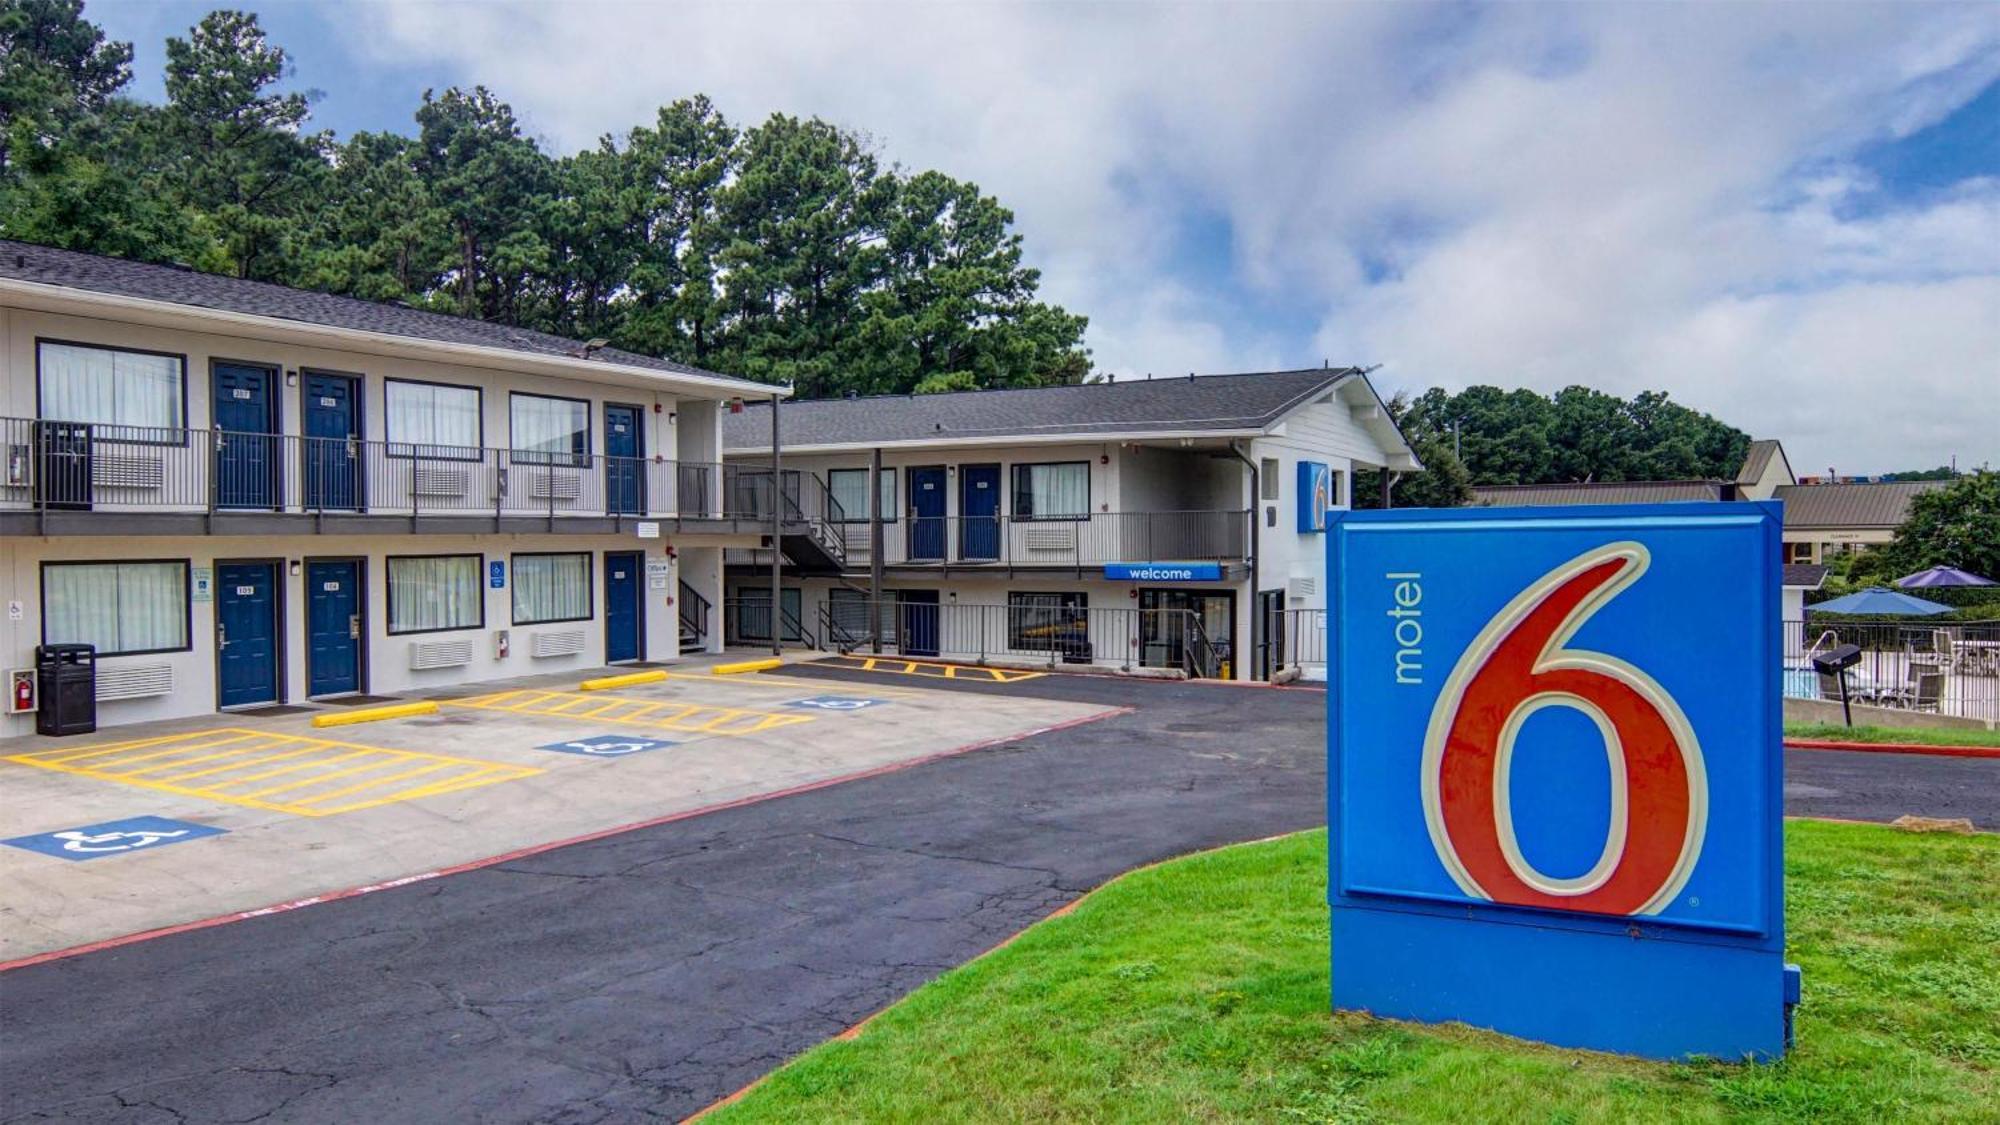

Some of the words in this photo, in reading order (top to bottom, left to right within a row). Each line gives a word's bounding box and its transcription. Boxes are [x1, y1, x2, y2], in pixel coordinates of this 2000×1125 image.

[1314, 468, 1328, 529] 6
[1129, 567, 1192, 579] welcome
[1386, 573, 1422, 683] motel
[1421, 541, 1708, 916] 6
